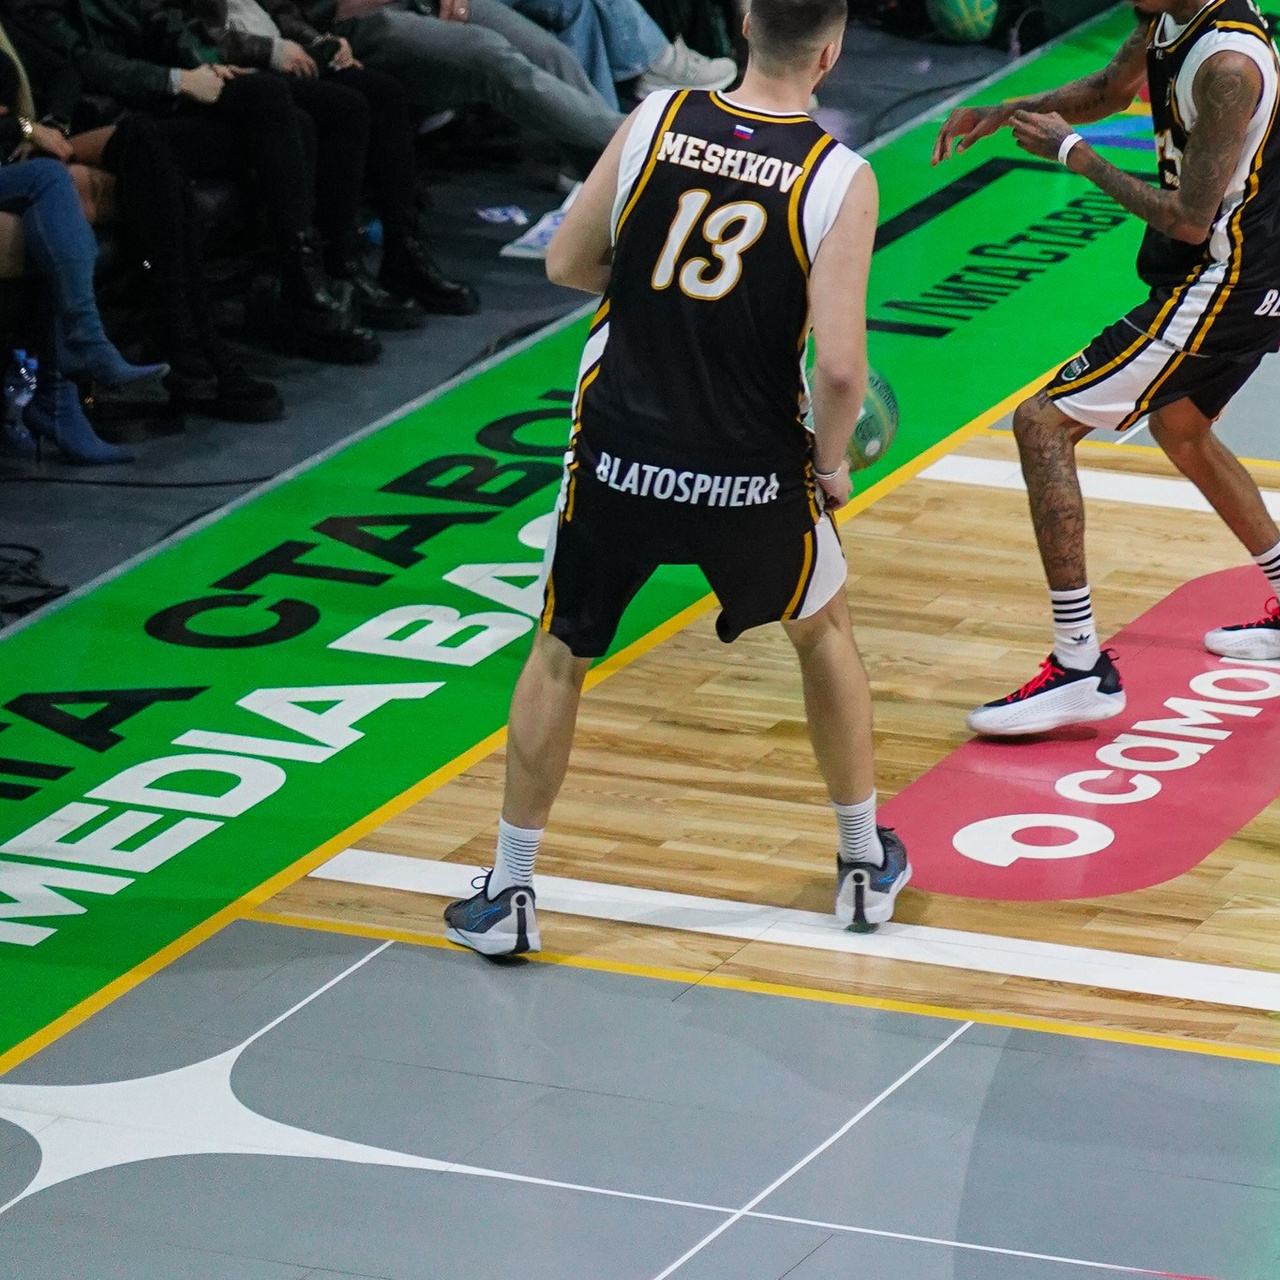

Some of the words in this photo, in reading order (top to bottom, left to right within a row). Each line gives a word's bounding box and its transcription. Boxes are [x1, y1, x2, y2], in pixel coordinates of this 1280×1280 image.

[655, 131, 804, 193] MESHKOV
[651, 188, 768, 301] 13
[144, 390, 577, 649] СТАВО
[595, 451, 780, 507] BLATOSPHERA
